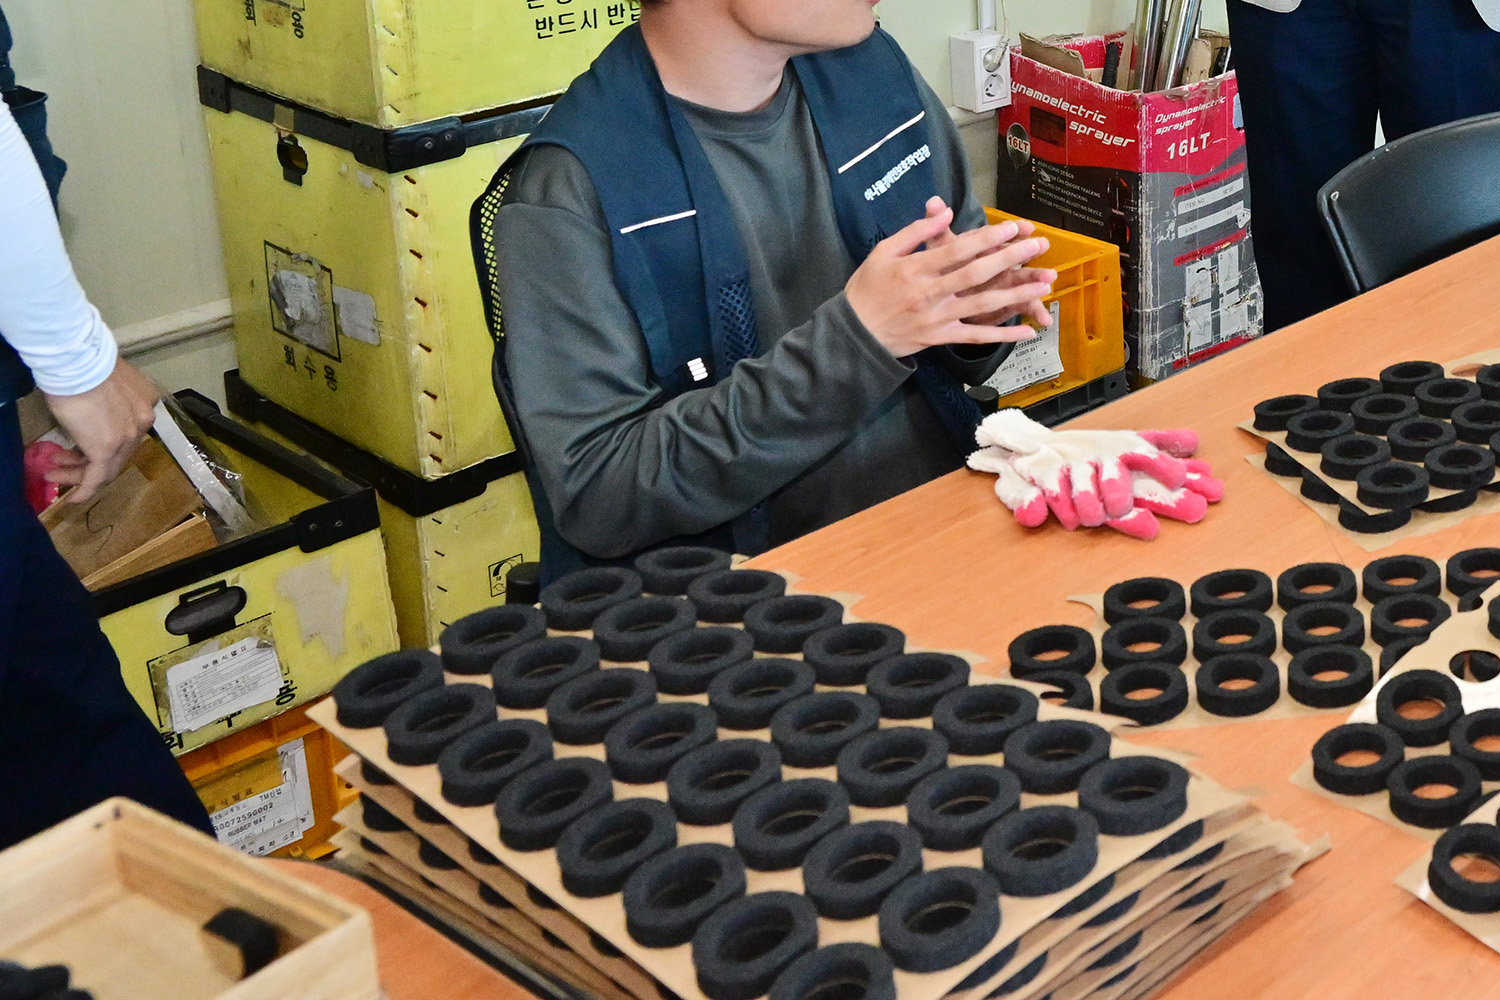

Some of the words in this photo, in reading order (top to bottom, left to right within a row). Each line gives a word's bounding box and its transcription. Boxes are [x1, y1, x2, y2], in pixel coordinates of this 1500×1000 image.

[291, 11, 304, 39] 용
[535, 8, 598, 40] 반드시
[1010, 76, 1107, 125] ynamoelectric
[1154, 96, 1227, 124] Dynamoelectric
[1069, 120, 1136, 148] sprayer
[1154, 118, 1197, 136] sprayer
[1007, 135, 1031, 153] 16LT
[1166, 131, 1211, 160] 16LT
[324, 365, 338, 392] 용
